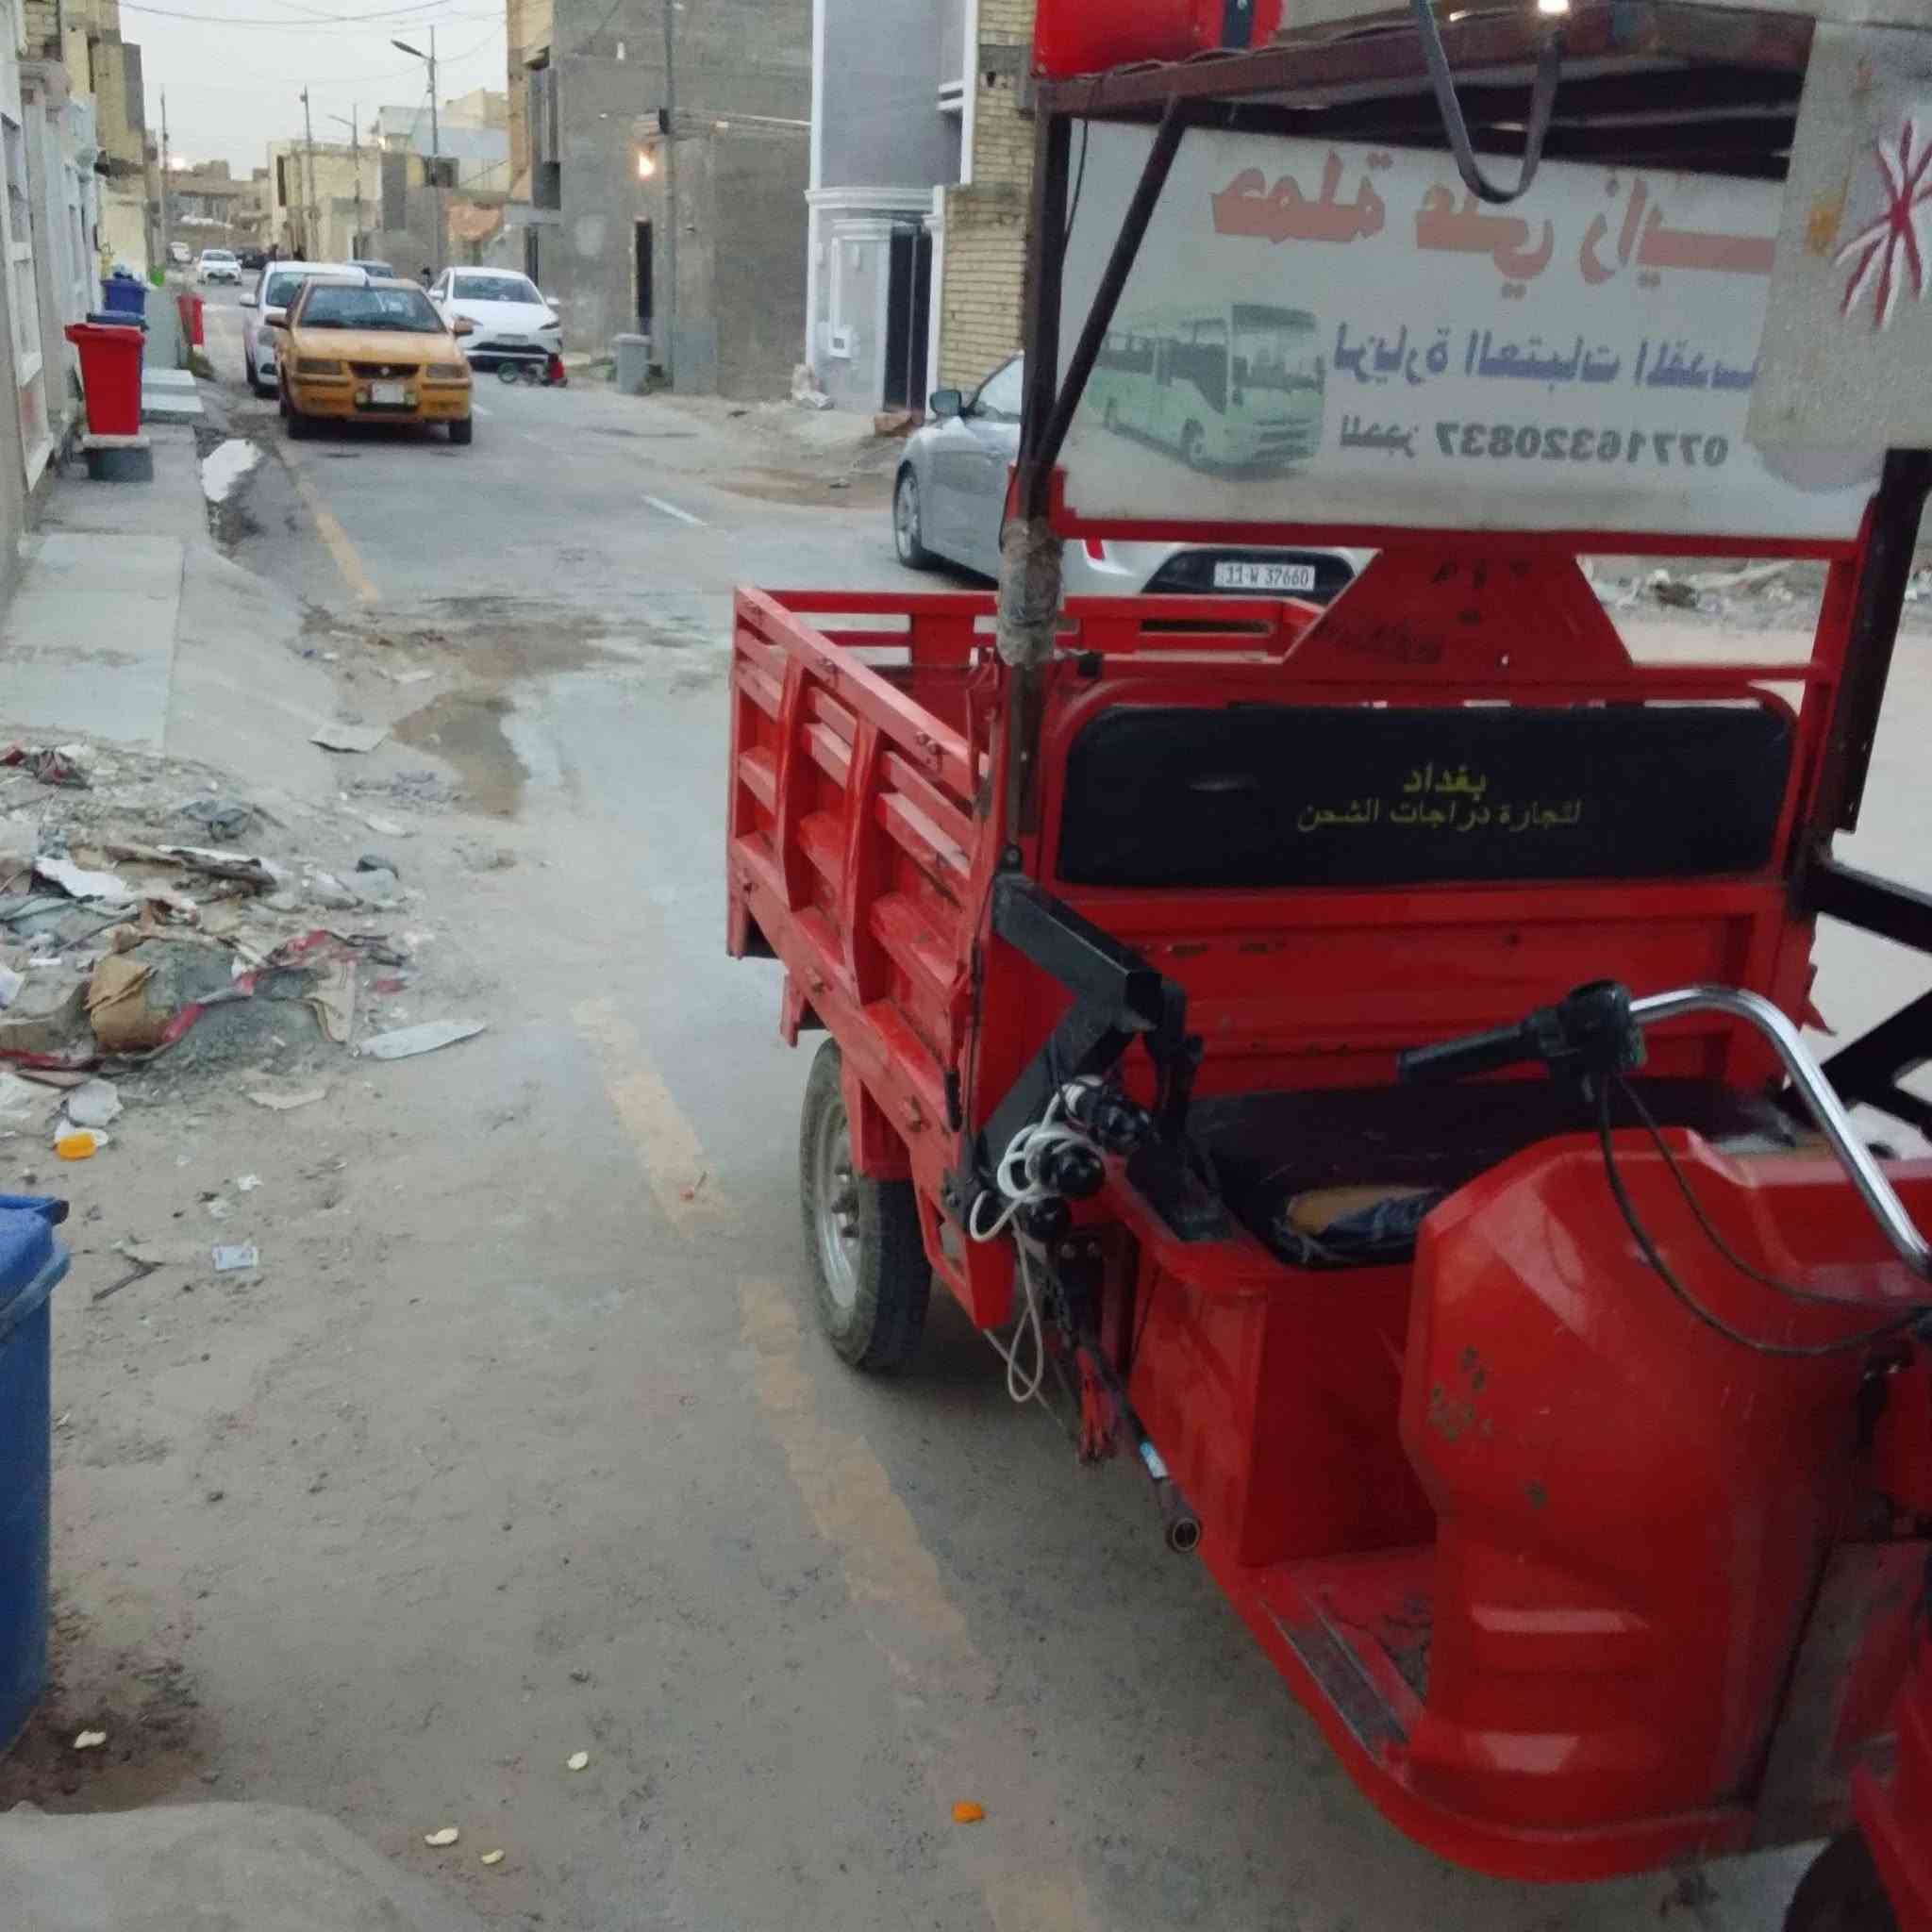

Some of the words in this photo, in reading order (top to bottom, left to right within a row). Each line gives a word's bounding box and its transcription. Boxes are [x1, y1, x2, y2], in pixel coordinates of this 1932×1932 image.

[1403, 760, 1488, 802] بغداد
[1296, 798, 1380, 833] الشحن
[1389, 798, 1492, 833] دراجات
[1497, 798, 1584, 833] لتجارة
